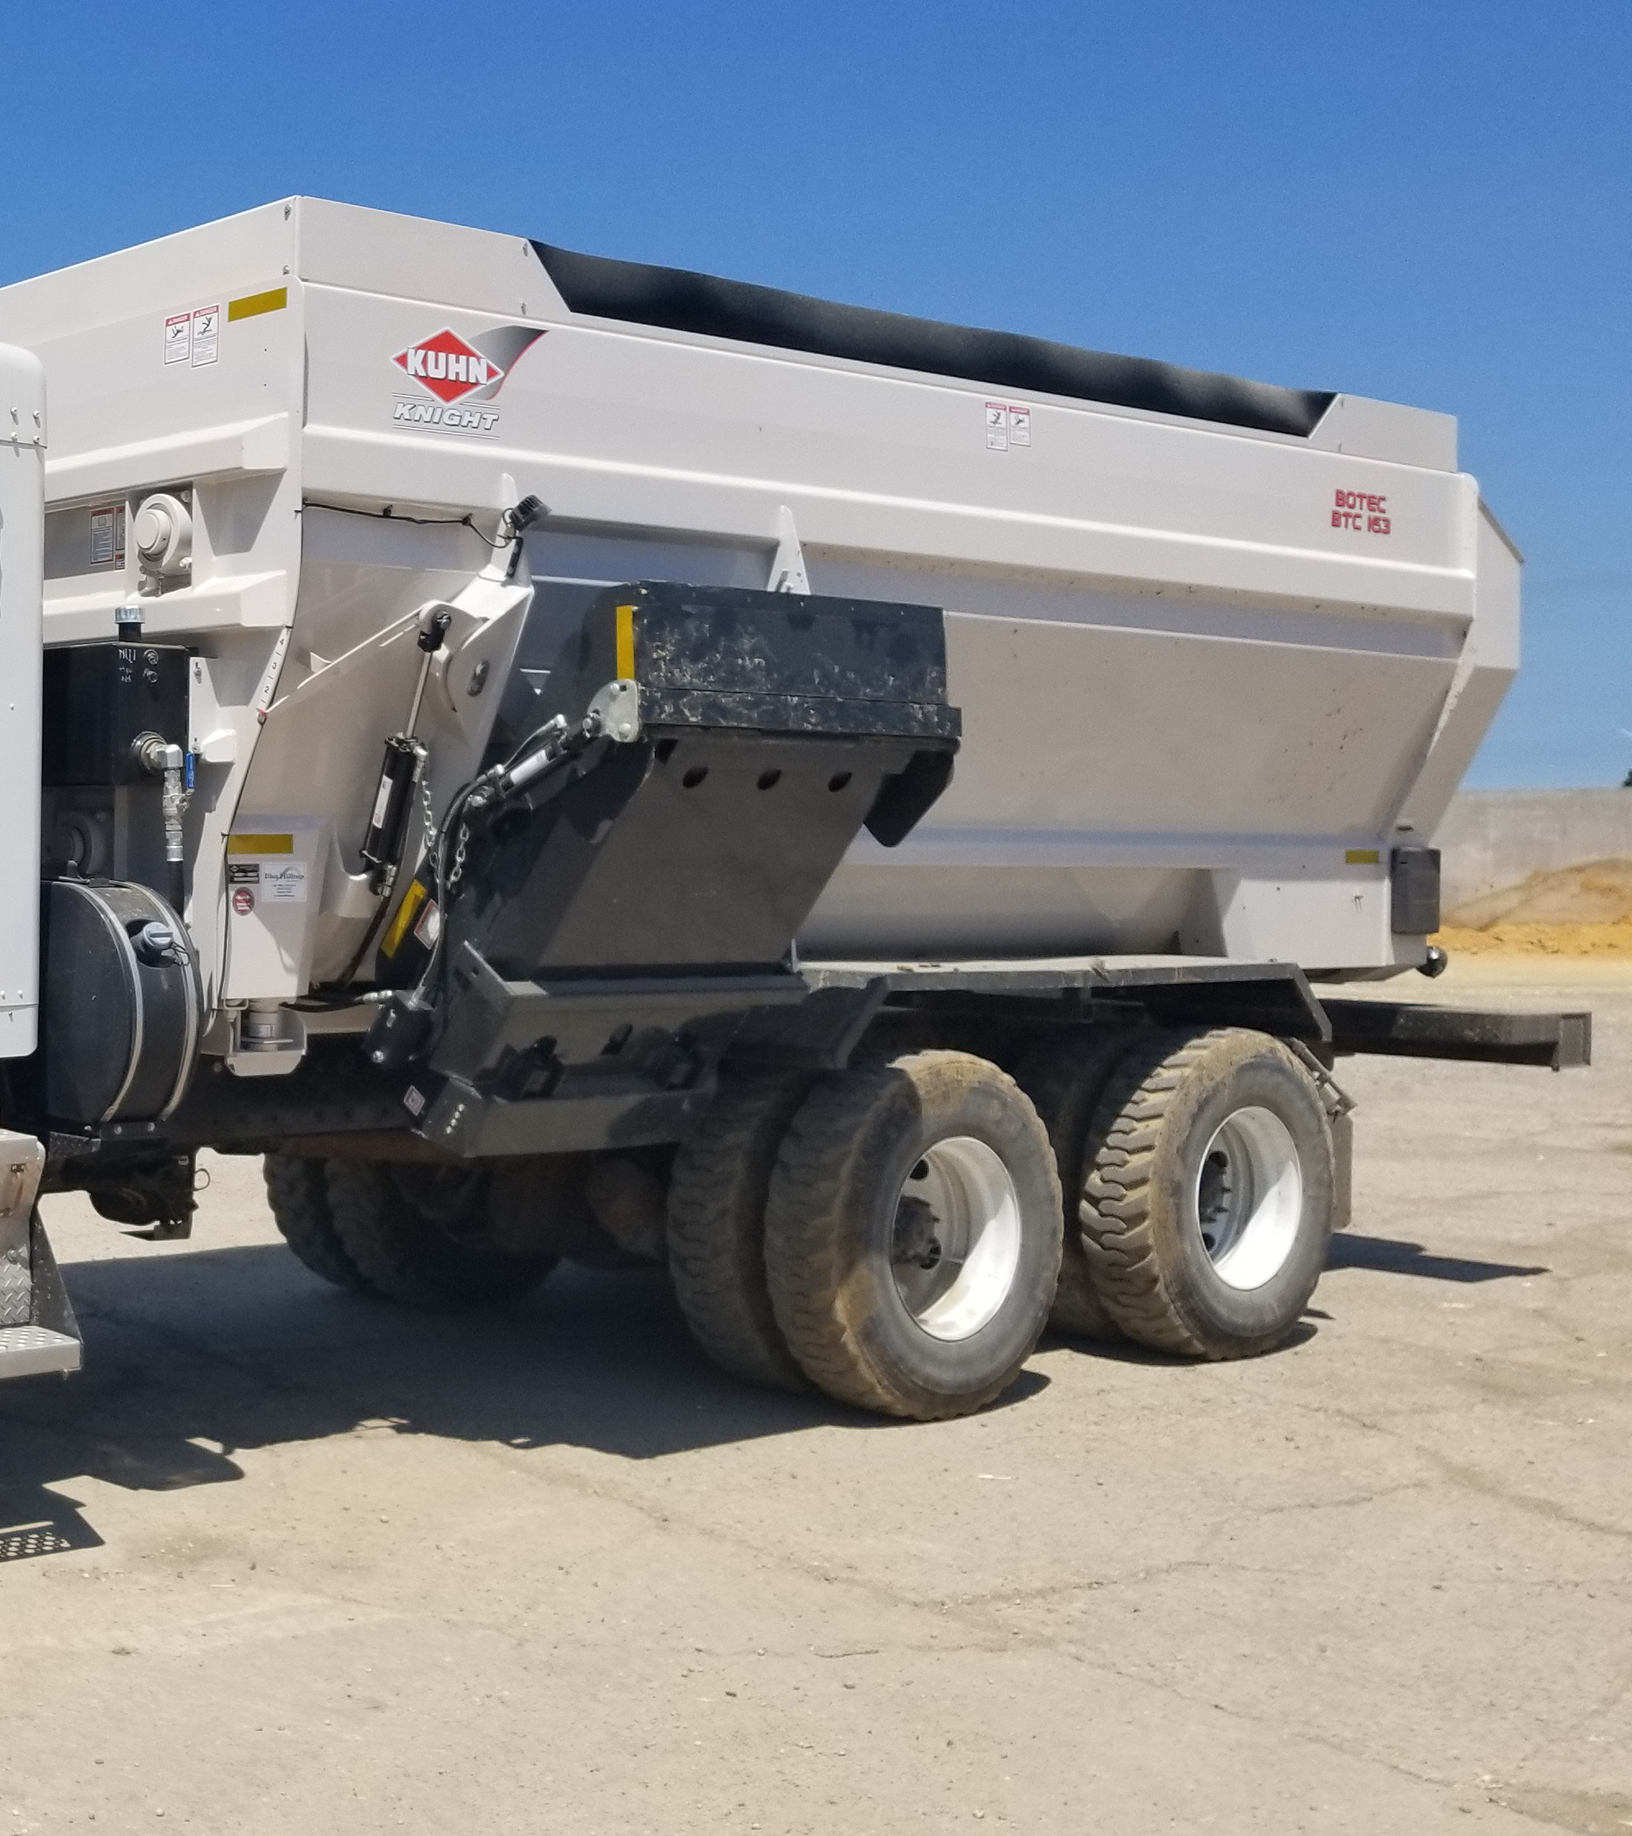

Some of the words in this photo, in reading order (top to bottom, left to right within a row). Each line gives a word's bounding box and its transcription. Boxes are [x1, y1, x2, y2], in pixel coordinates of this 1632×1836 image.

[407, 347, 488, 385] KUHN
[393, 401, 499, 430] KNIGHT
[1335, 489, 1387, 513] BOTEC
[1331, 510, 1363, 531] BTC
